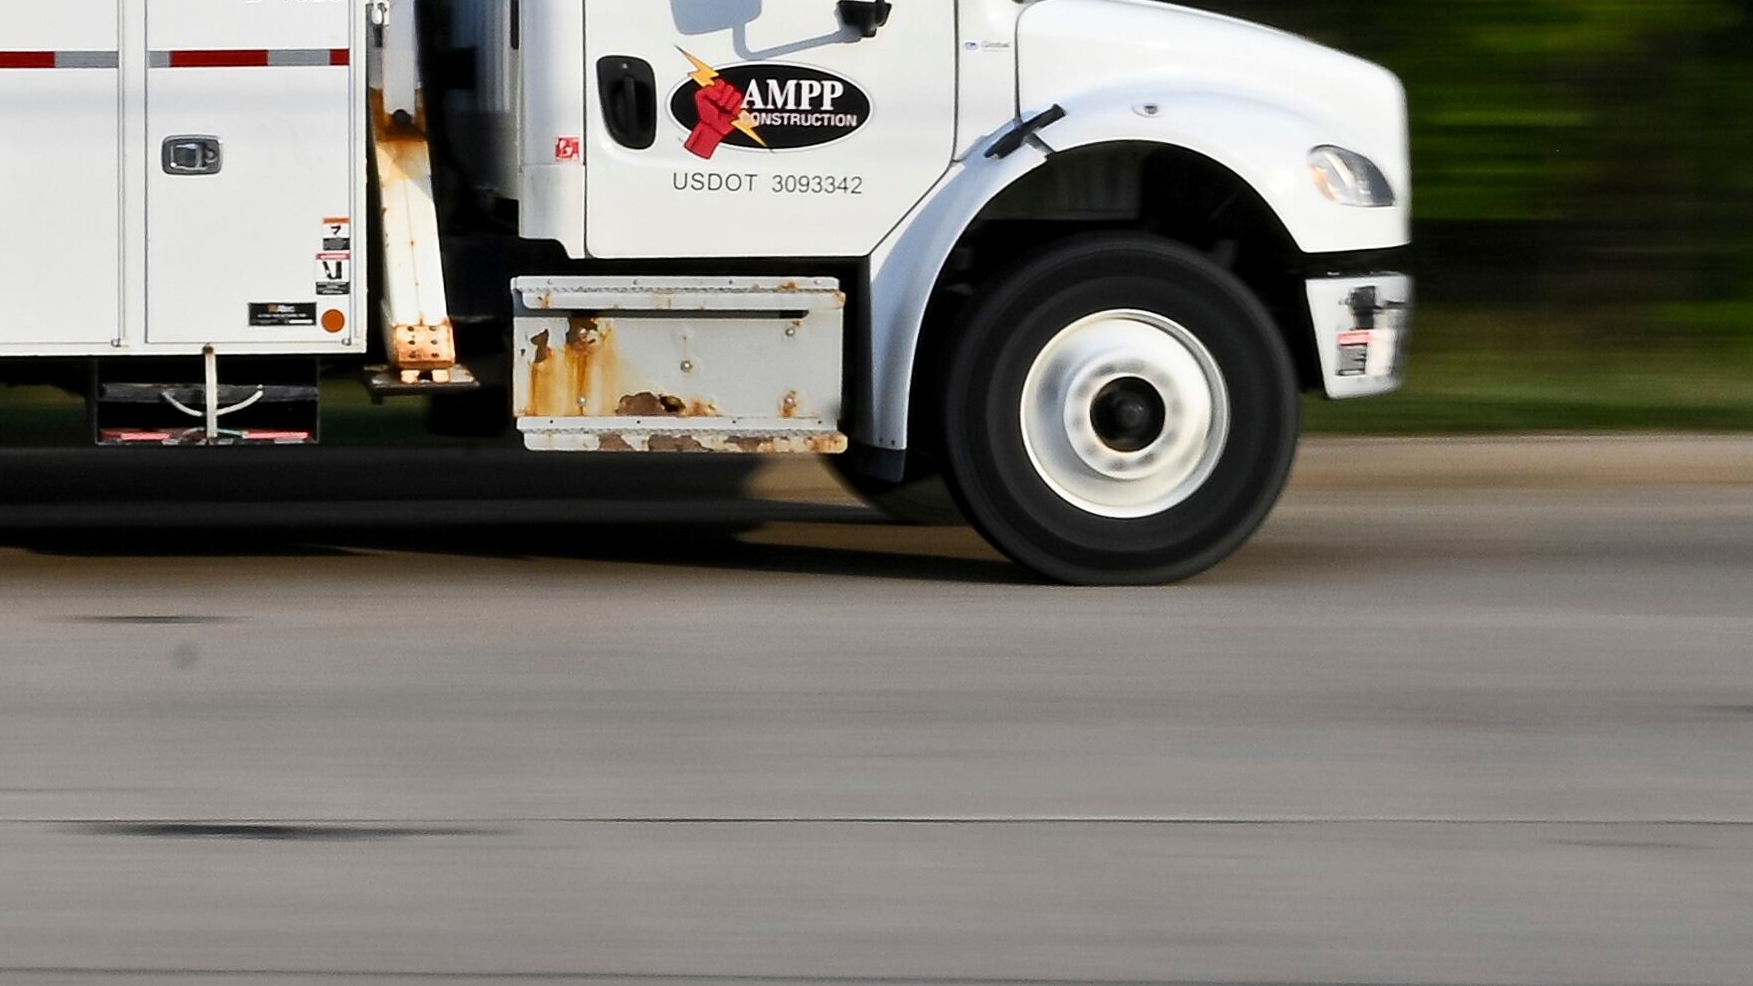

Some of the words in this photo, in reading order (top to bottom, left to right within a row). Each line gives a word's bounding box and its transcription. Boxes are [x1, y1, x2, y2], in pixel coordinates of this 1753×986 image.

[740, 78, 844, 111] AMPP
[672, 172, 758, 192] USDOT
[771, 174, 863, 195] 3093342
